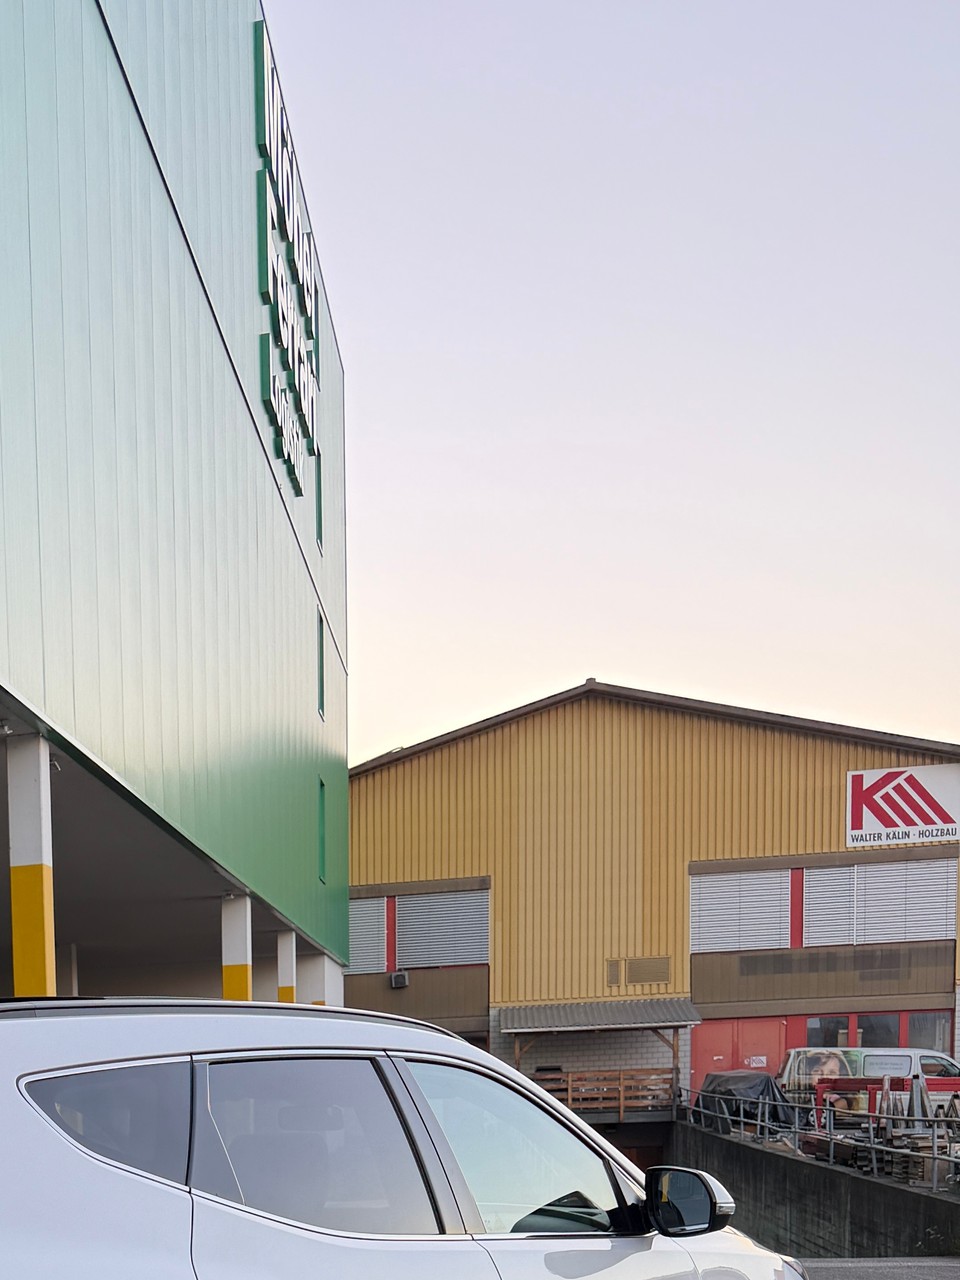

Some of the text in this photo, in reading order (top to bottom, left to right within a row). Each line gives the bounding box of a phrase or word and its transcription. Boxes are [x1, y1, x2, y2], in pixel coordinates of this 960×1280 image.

[262, 20, 315, 340] Möbel
[265, 168, 318, 456] Ferrari
[269, 334, 305, 497] Logistik
[851, 828, 957, 843] WALTER KÄLIN HOLZBAU
